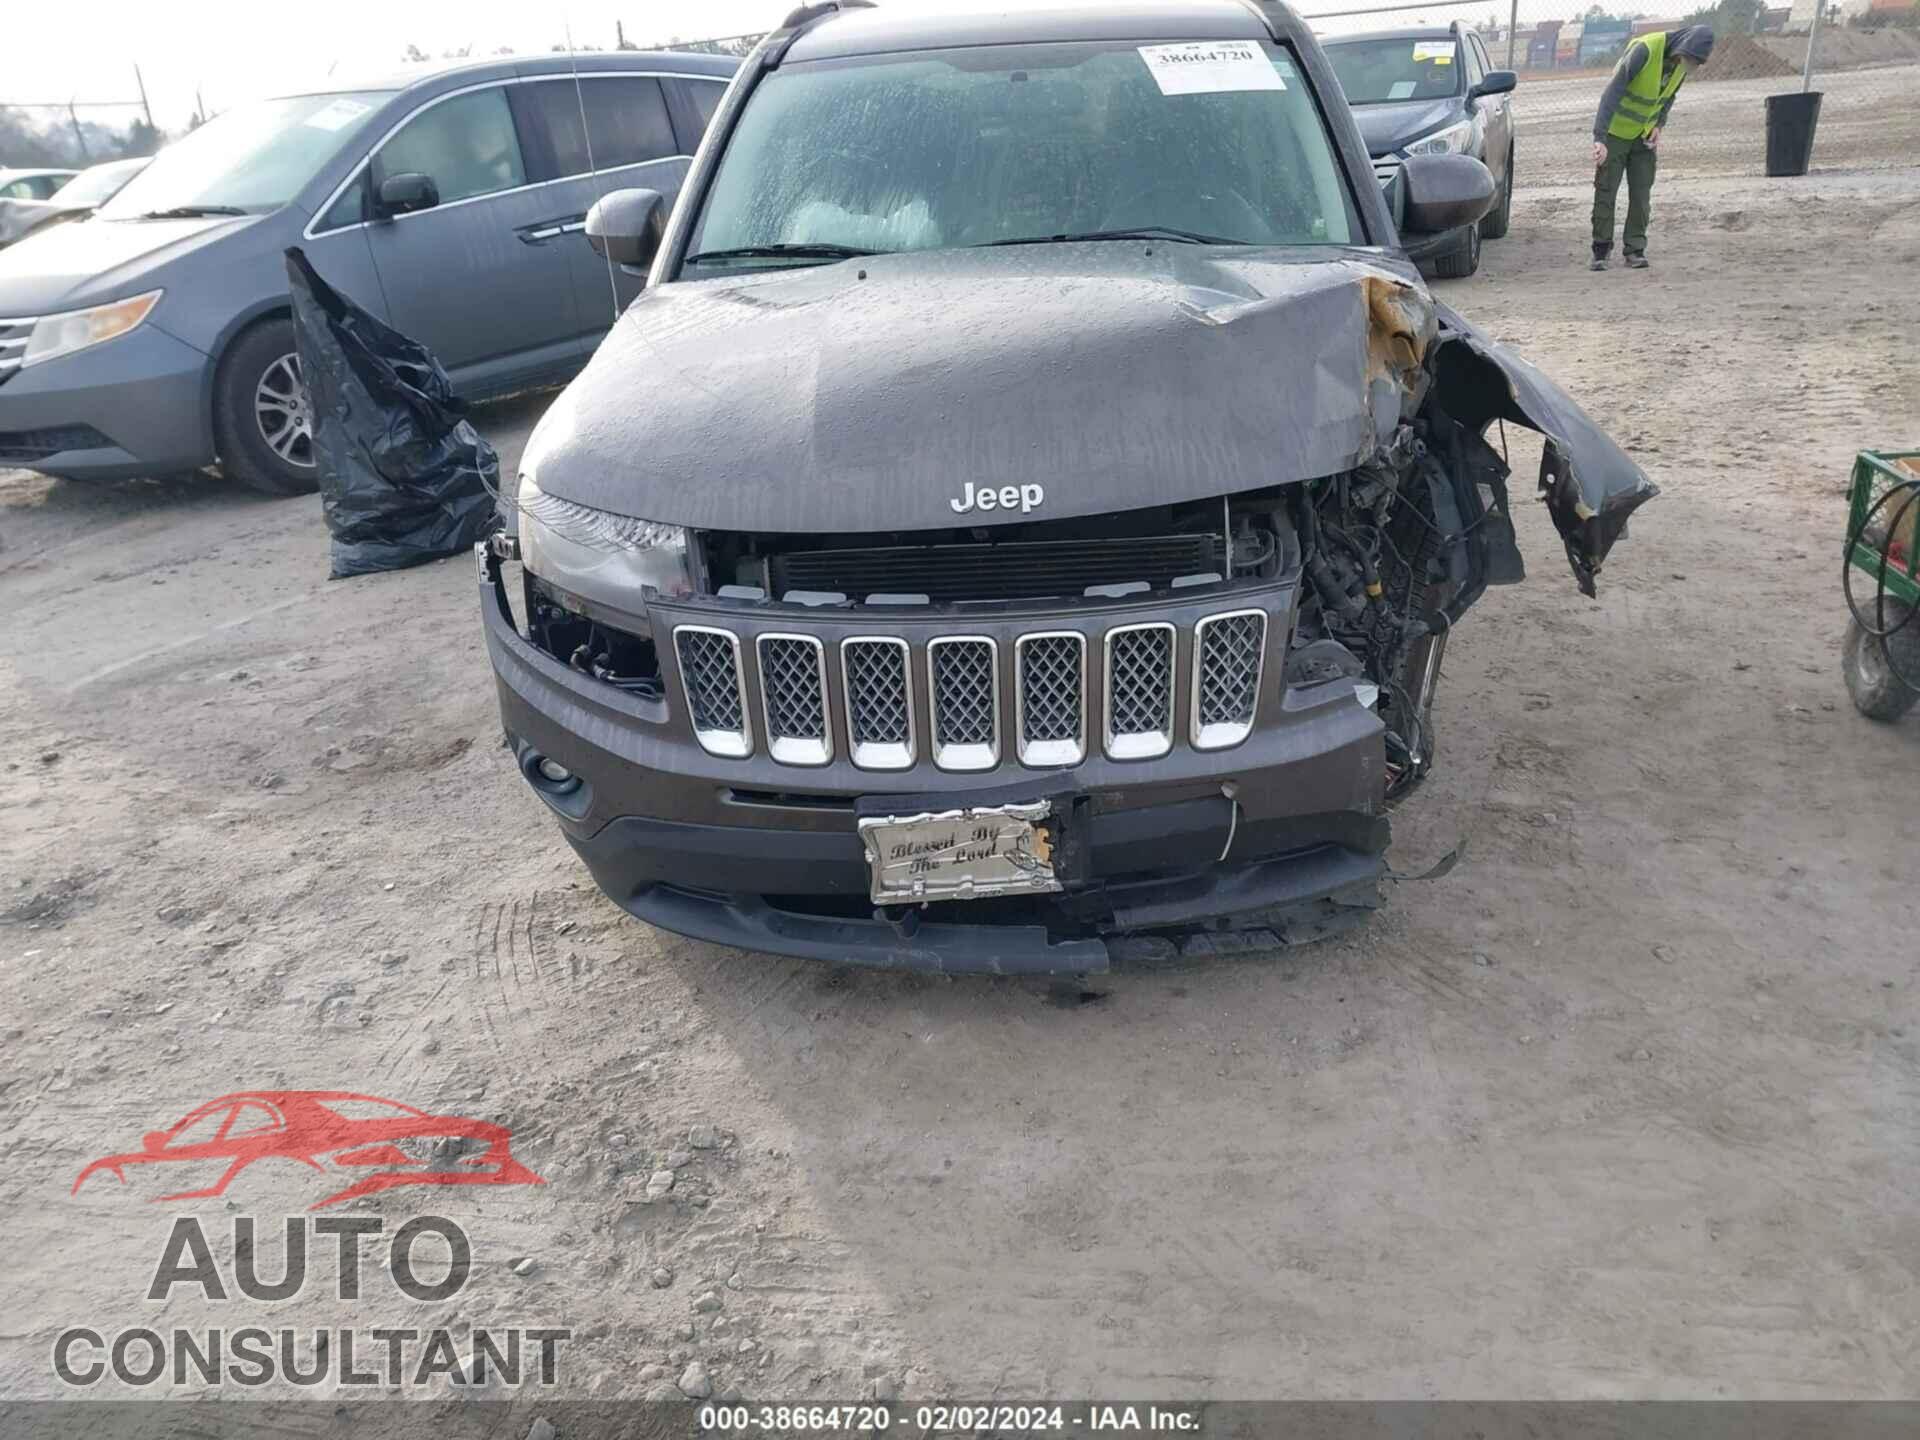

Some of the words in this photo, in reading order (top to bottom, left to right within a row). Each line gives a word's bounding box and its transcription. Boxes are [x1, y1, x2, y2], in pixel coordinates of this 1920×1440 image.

[1157, 50, 1253, 65] 38664720
[950, 482, 1044, 513] Jeep
[890, 832, 956, 860] Blessed
[971, 826, 1000, 843] By
[909, 857, 941, 875] The
[952, 842, 997, 865] Lord
